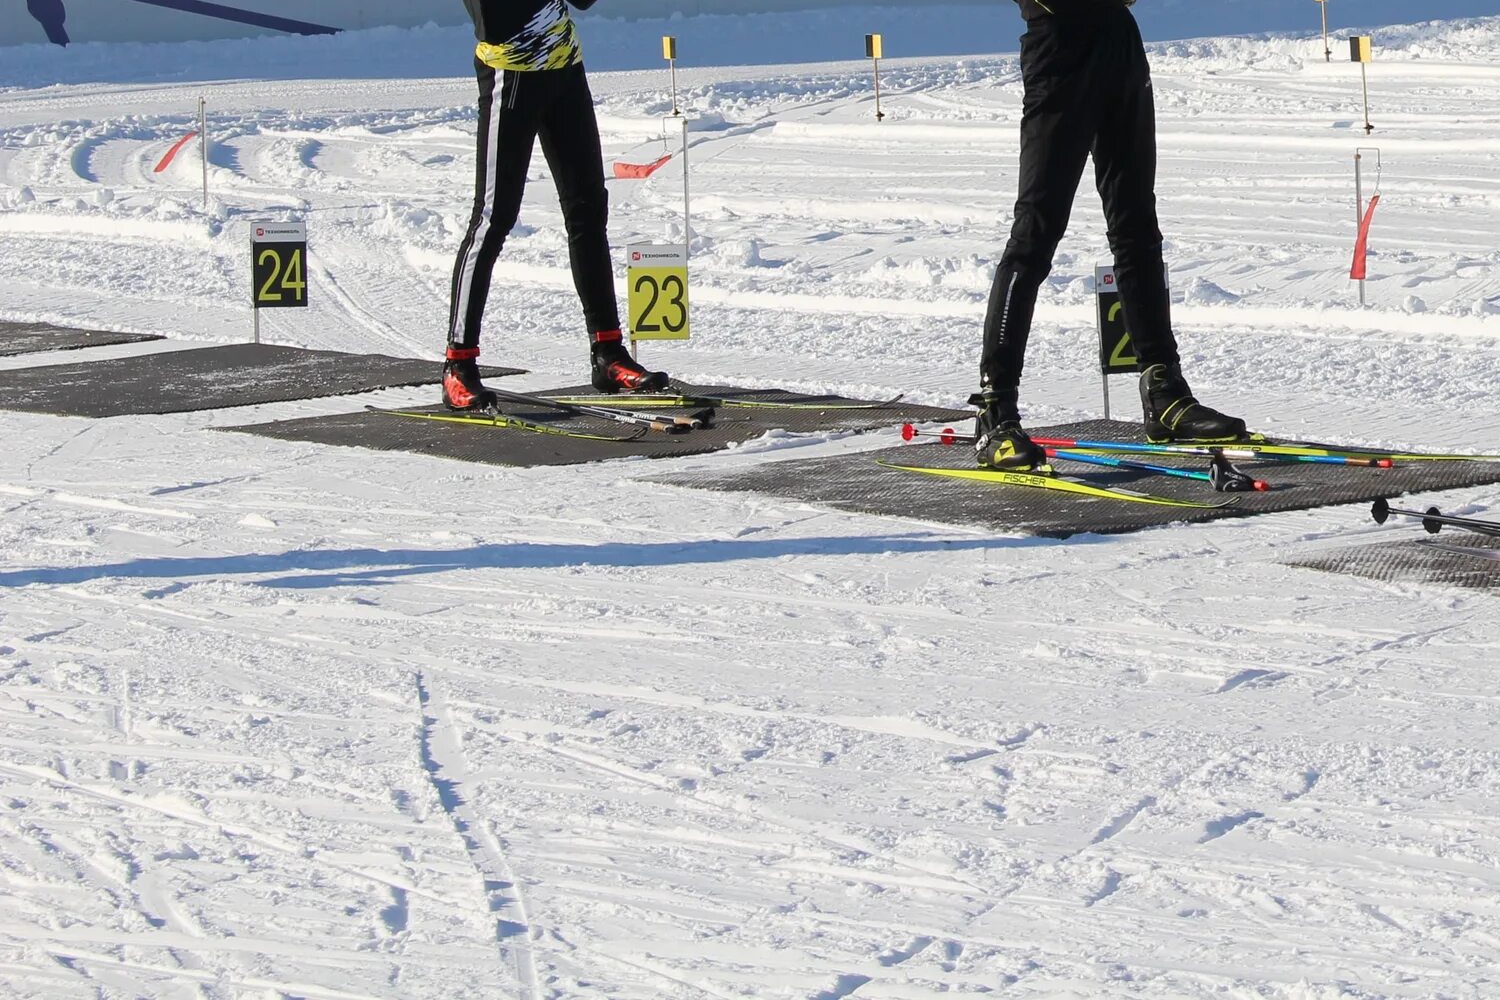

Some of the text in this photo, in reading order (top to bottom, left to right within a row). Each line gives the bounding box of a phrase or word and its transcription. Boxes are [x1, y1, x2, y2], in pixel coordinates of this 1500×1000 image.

[258, 249, 306, 301] 24
[635, 275, 687, 333] 23
[1107, 301, 1138, 367] 2
[1003, 474, 1047, 486] FISCHER
